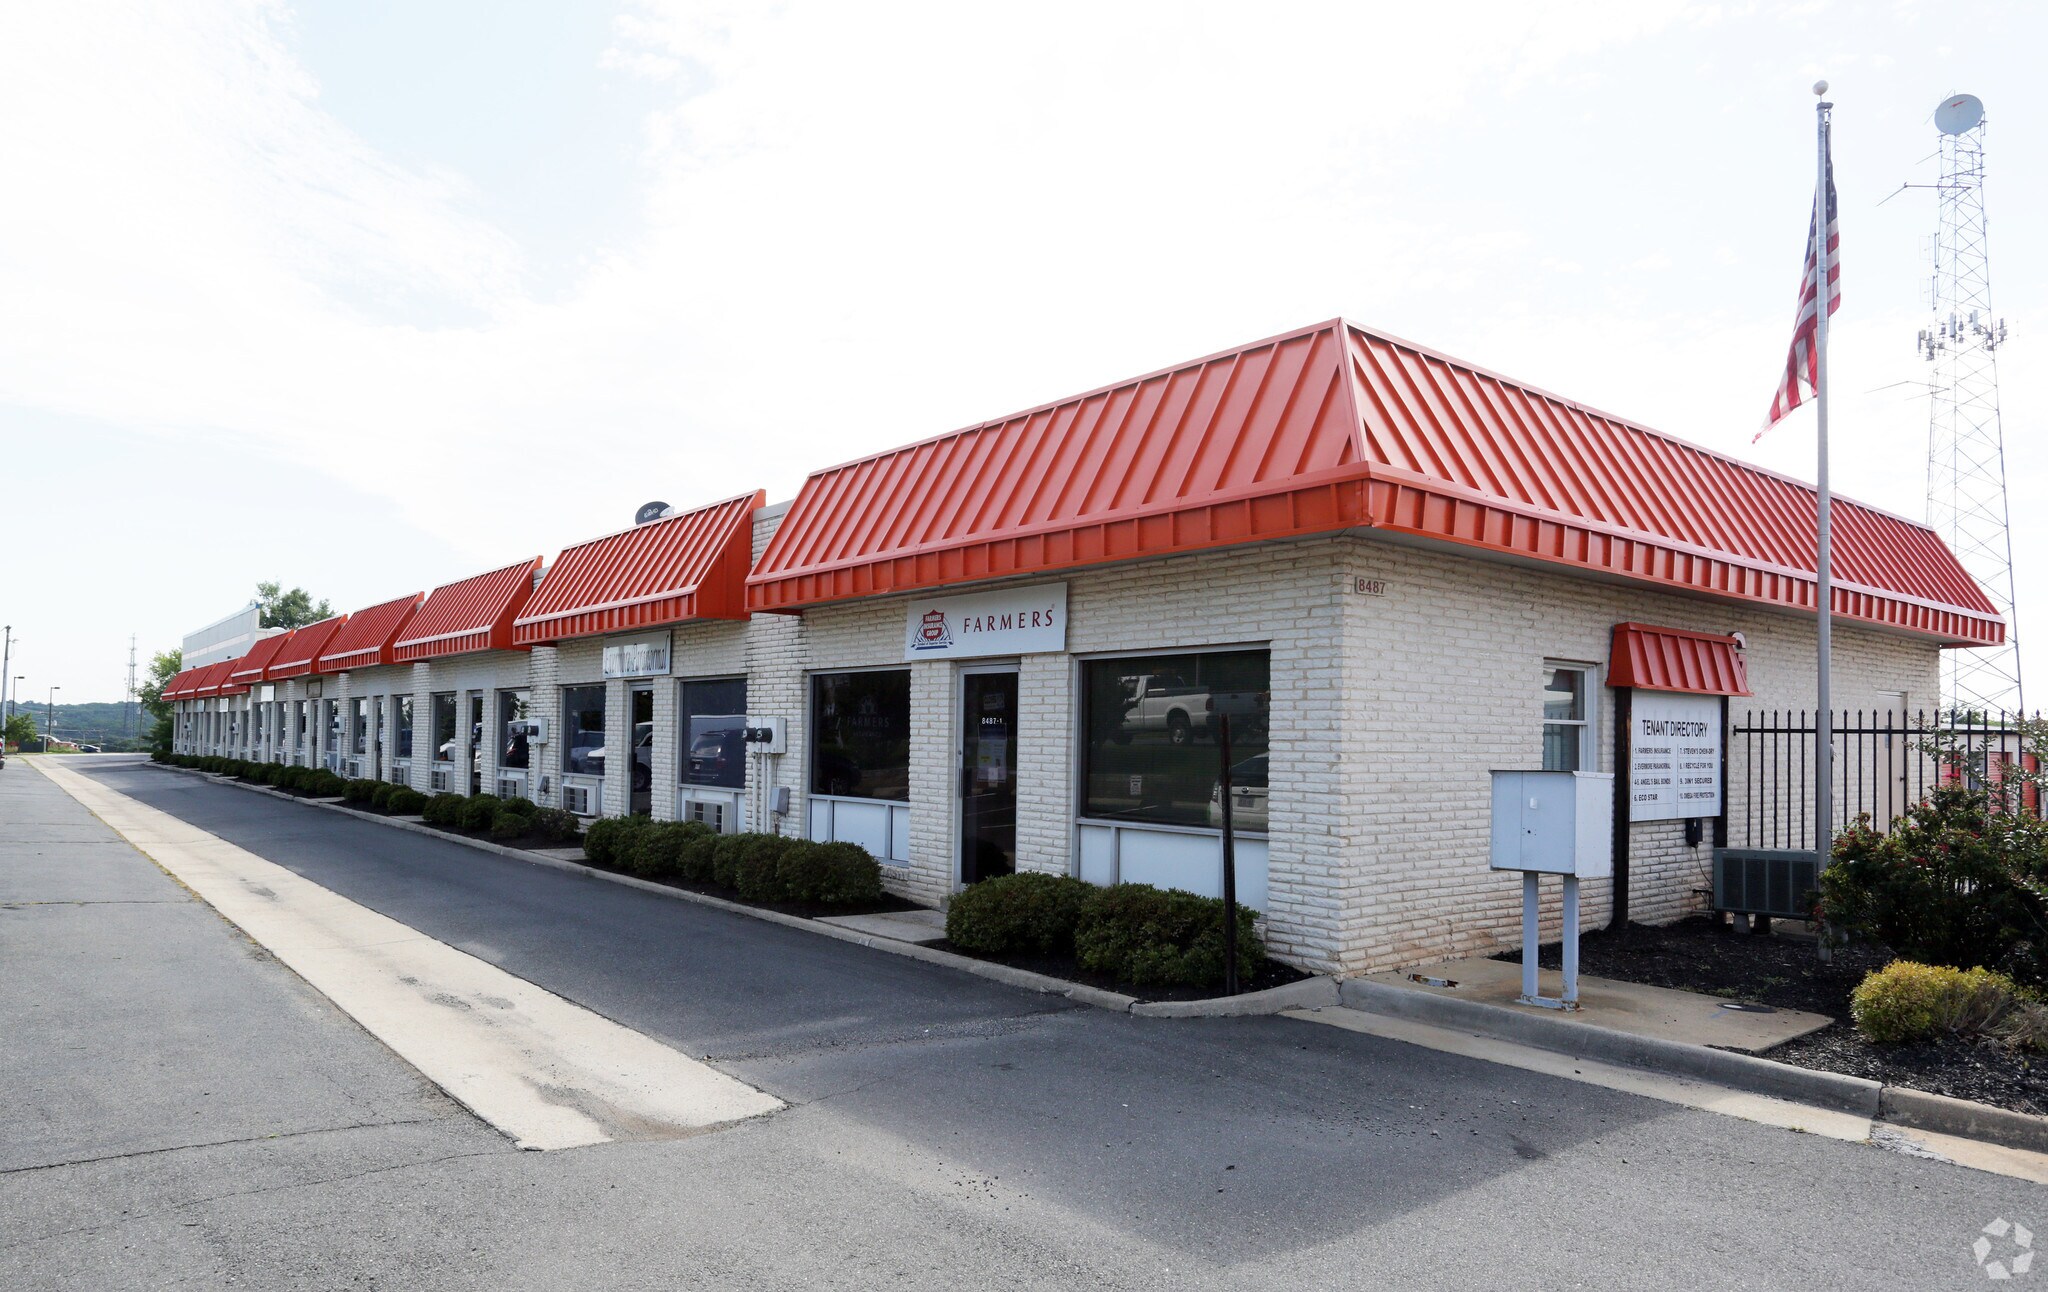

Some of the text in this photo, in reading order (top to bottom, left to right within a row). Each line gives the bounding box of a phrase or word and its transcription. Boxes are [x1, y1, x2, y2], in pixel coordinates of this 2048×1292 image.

[1358, 578, 1386, 595] 8487
[963, 609, 1054, 634] FARMERS
[981, 717, 1002, 725] 8487-1
[1642, 720, 1708, 737] TENANT DIRECTORY
